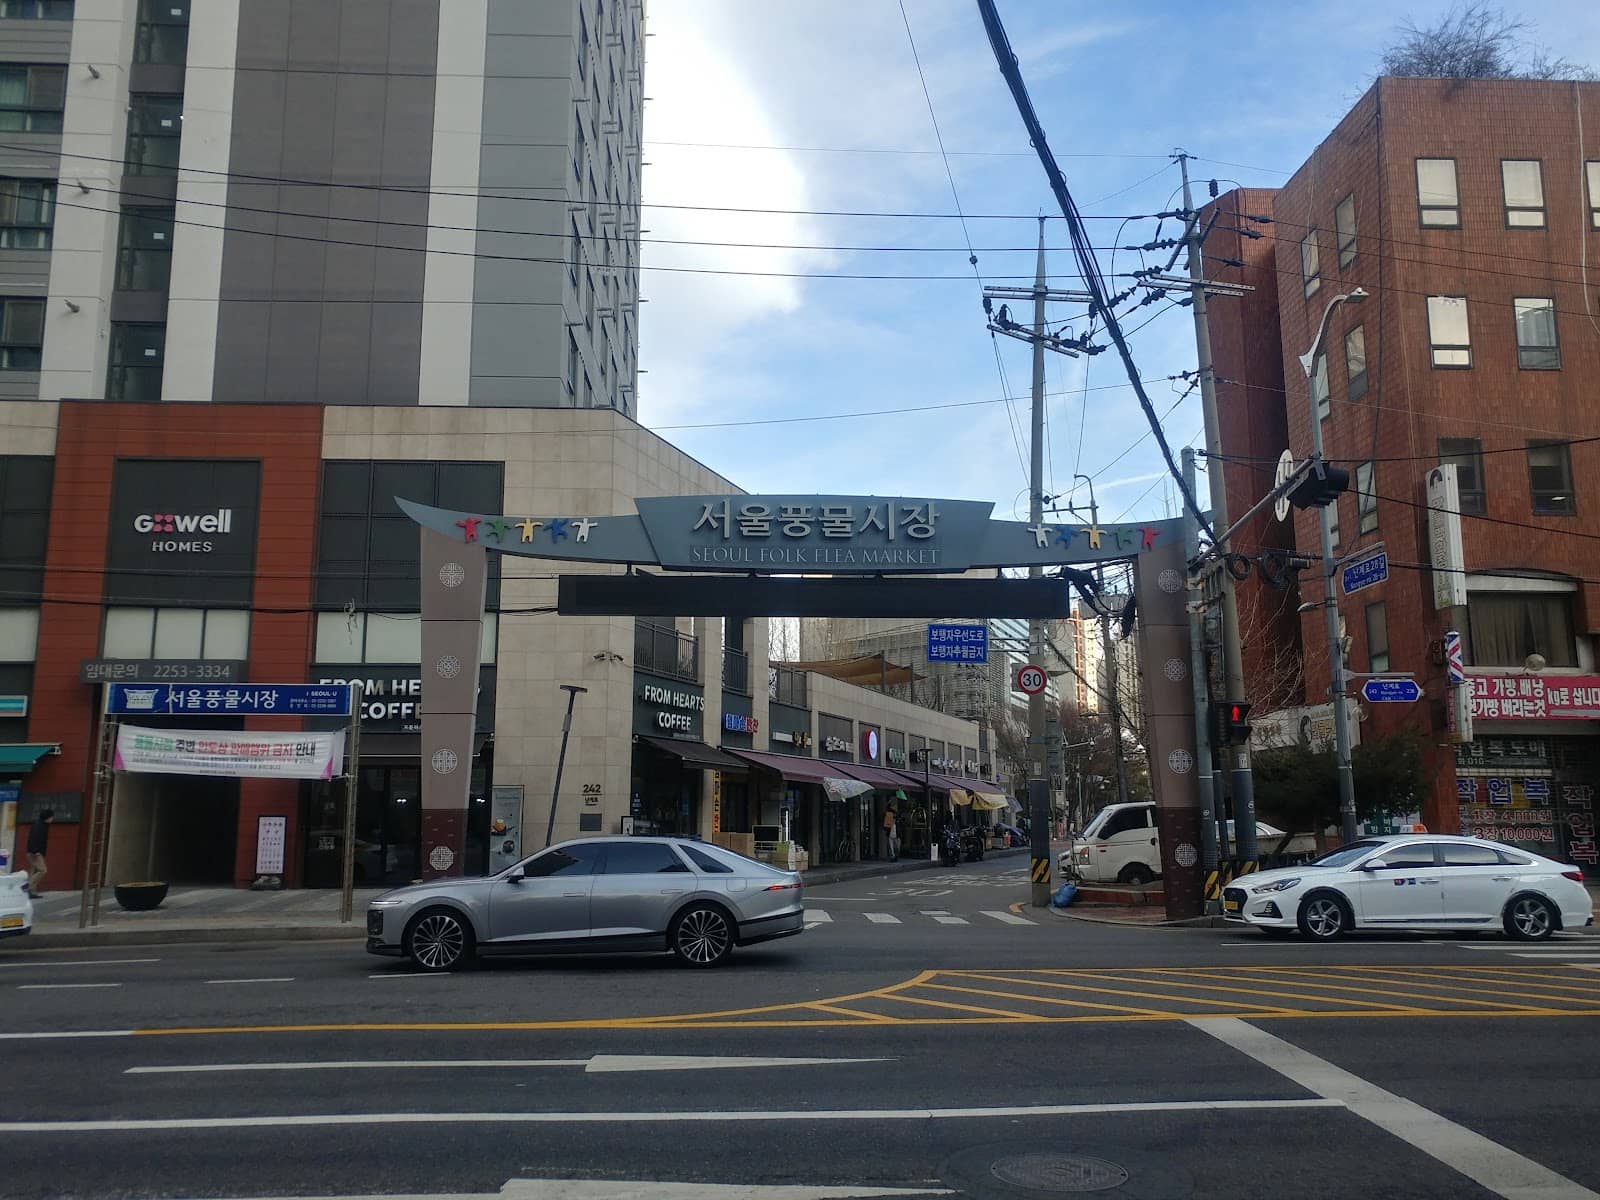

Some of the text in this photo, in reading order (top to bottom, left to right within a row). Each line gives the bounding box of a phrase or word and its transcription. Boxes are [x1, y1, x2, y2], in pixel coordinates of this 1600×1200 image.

[692, 498, 941, 541] 서울풍물시장
[152, 541, 213, 552] HOMES
[692, 547, 939, 565] SEOUL FOLK FLEA MARKET
[930, 628, 985, 642] 보행자우선도로
[930, 645, 985, 659] 보행자추월금지
[86, 663, 231, 679] 임대문의 2253-3334
[1022, 673, 1042, 687] 30
[165, 688, 279, 710] 서울풍물시장
[644, 685, 705, 712] FROM HEARTS
[658, 712, 692, 732] COFFEE
[175, 739, 196, 753] 주변
[295, 741, 316, 757] 안내
[583, 783, 601, 793] 242
[1456, 777, 1550, 805] 작업복
[1563, 785, 1599, 865] 작업복
[1500, 827, 1555, 842] 10,000원
